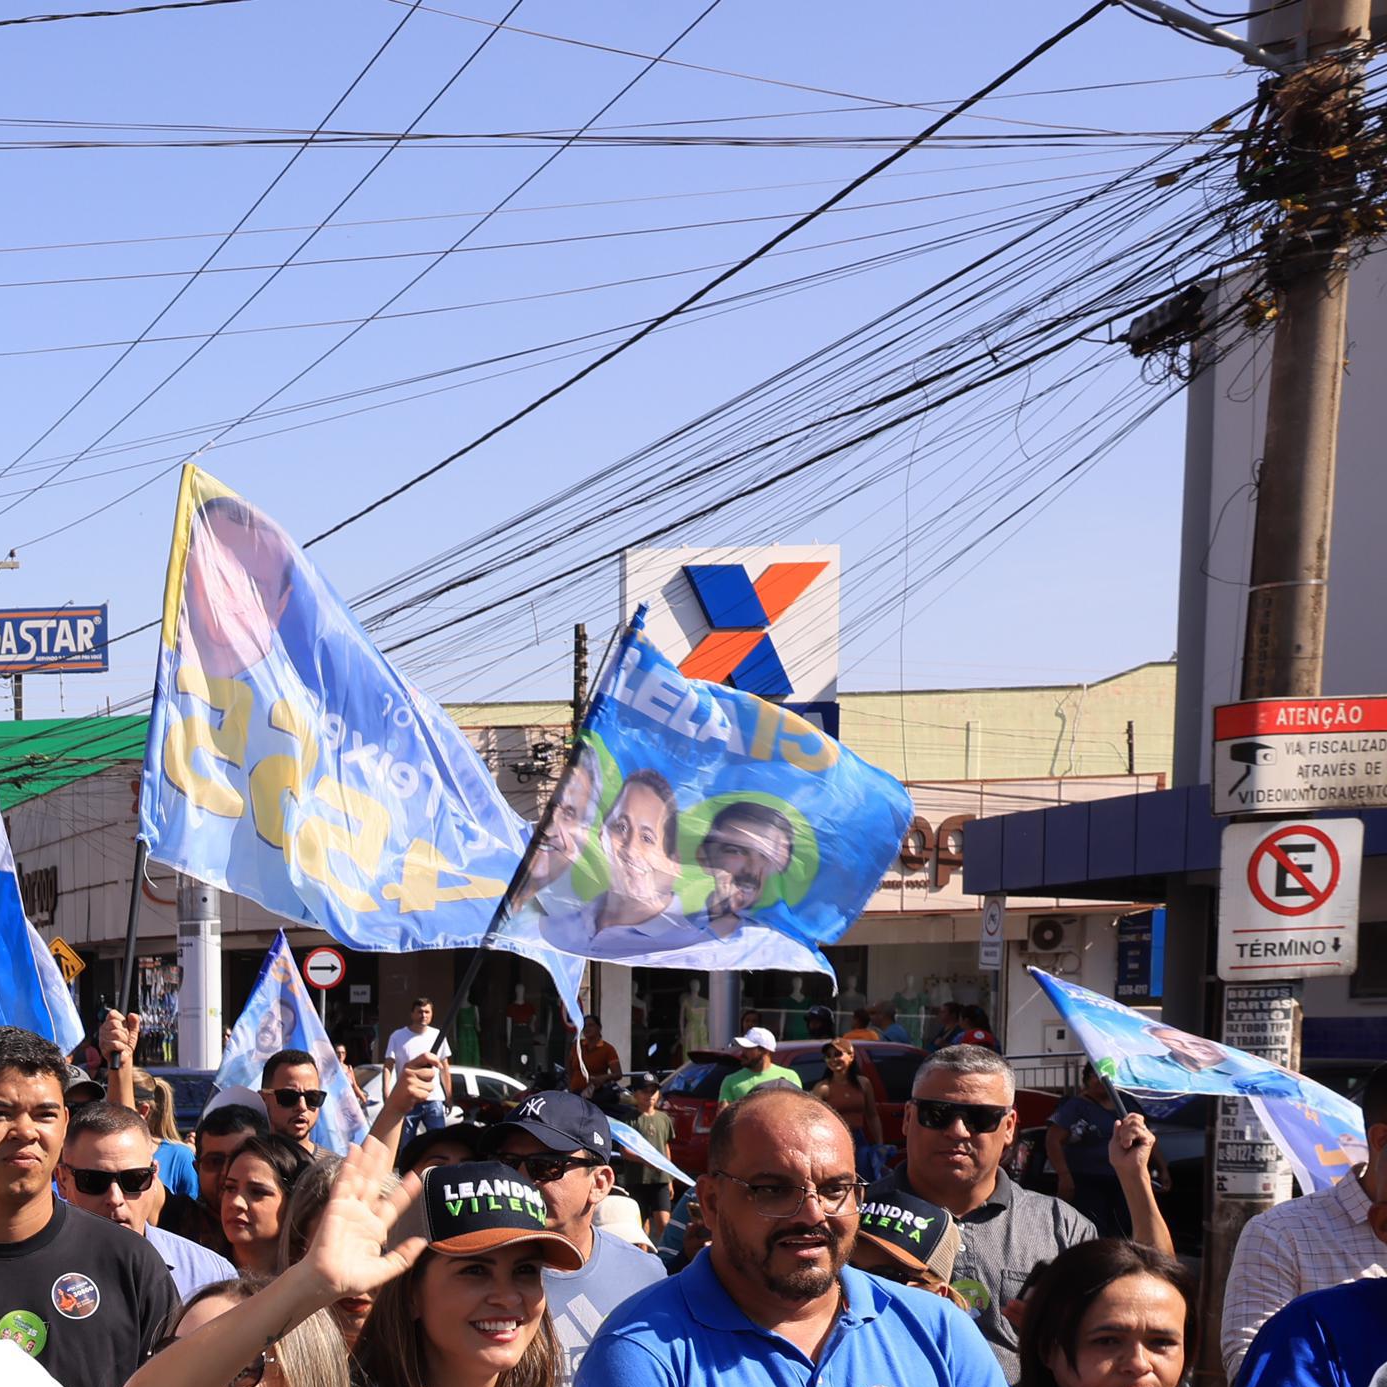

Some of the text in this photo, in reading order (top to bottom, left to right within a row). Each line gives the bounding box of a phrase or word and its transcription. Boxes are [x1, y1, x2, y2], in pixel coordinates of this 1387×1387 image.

[1276, 704, 1364, 730] ATENÇÃO
[1284, 741, 1301, 756] VIA
[1296, 760, 1382, 778] ATRAVÉS DE
[1234, 938, 1327, 959] TÉRMINO
[1227, 999, 1292, 1010] CARTAS
[1236, 1035, 1287, 1047] TRABALHO
